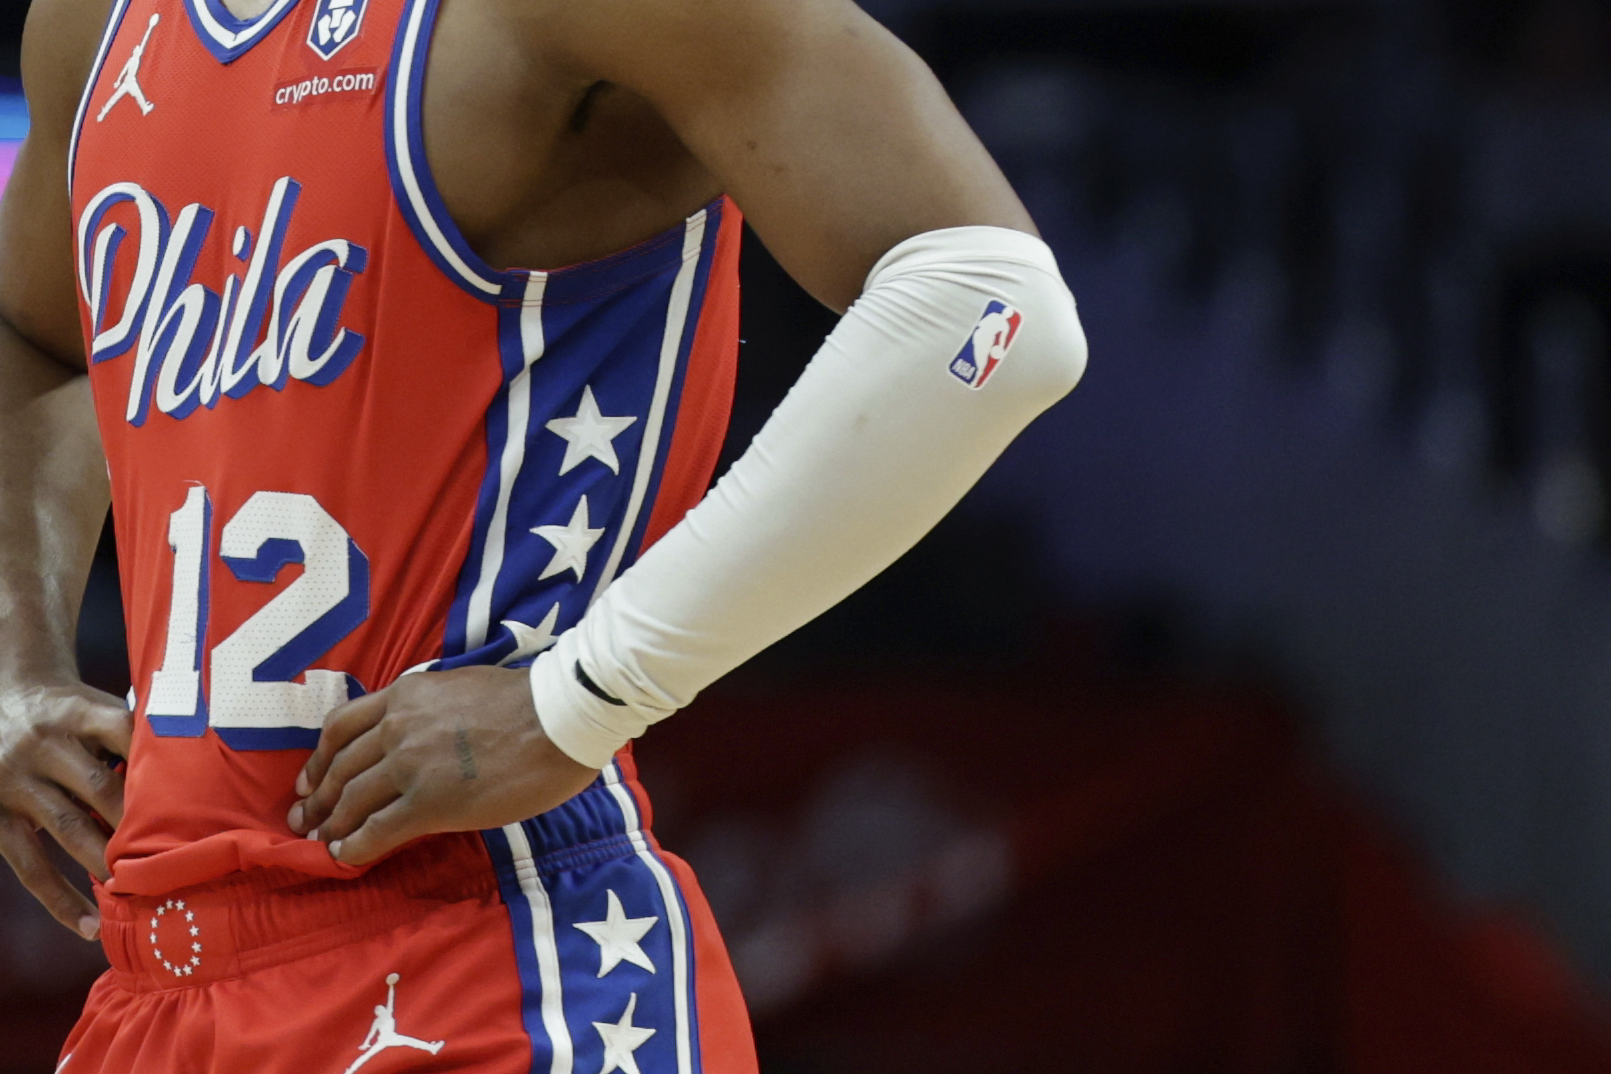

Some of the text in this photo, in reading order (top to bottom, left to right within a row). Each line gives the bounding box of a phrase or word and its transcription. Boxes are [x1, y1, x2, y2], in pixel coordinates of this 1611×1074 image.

[275, 73, 374, 105] crypto.com
[78, 176, 368, 427] Phila
[952, 358, 976, 380] NBA
[145, 485, 370, 750] 12
